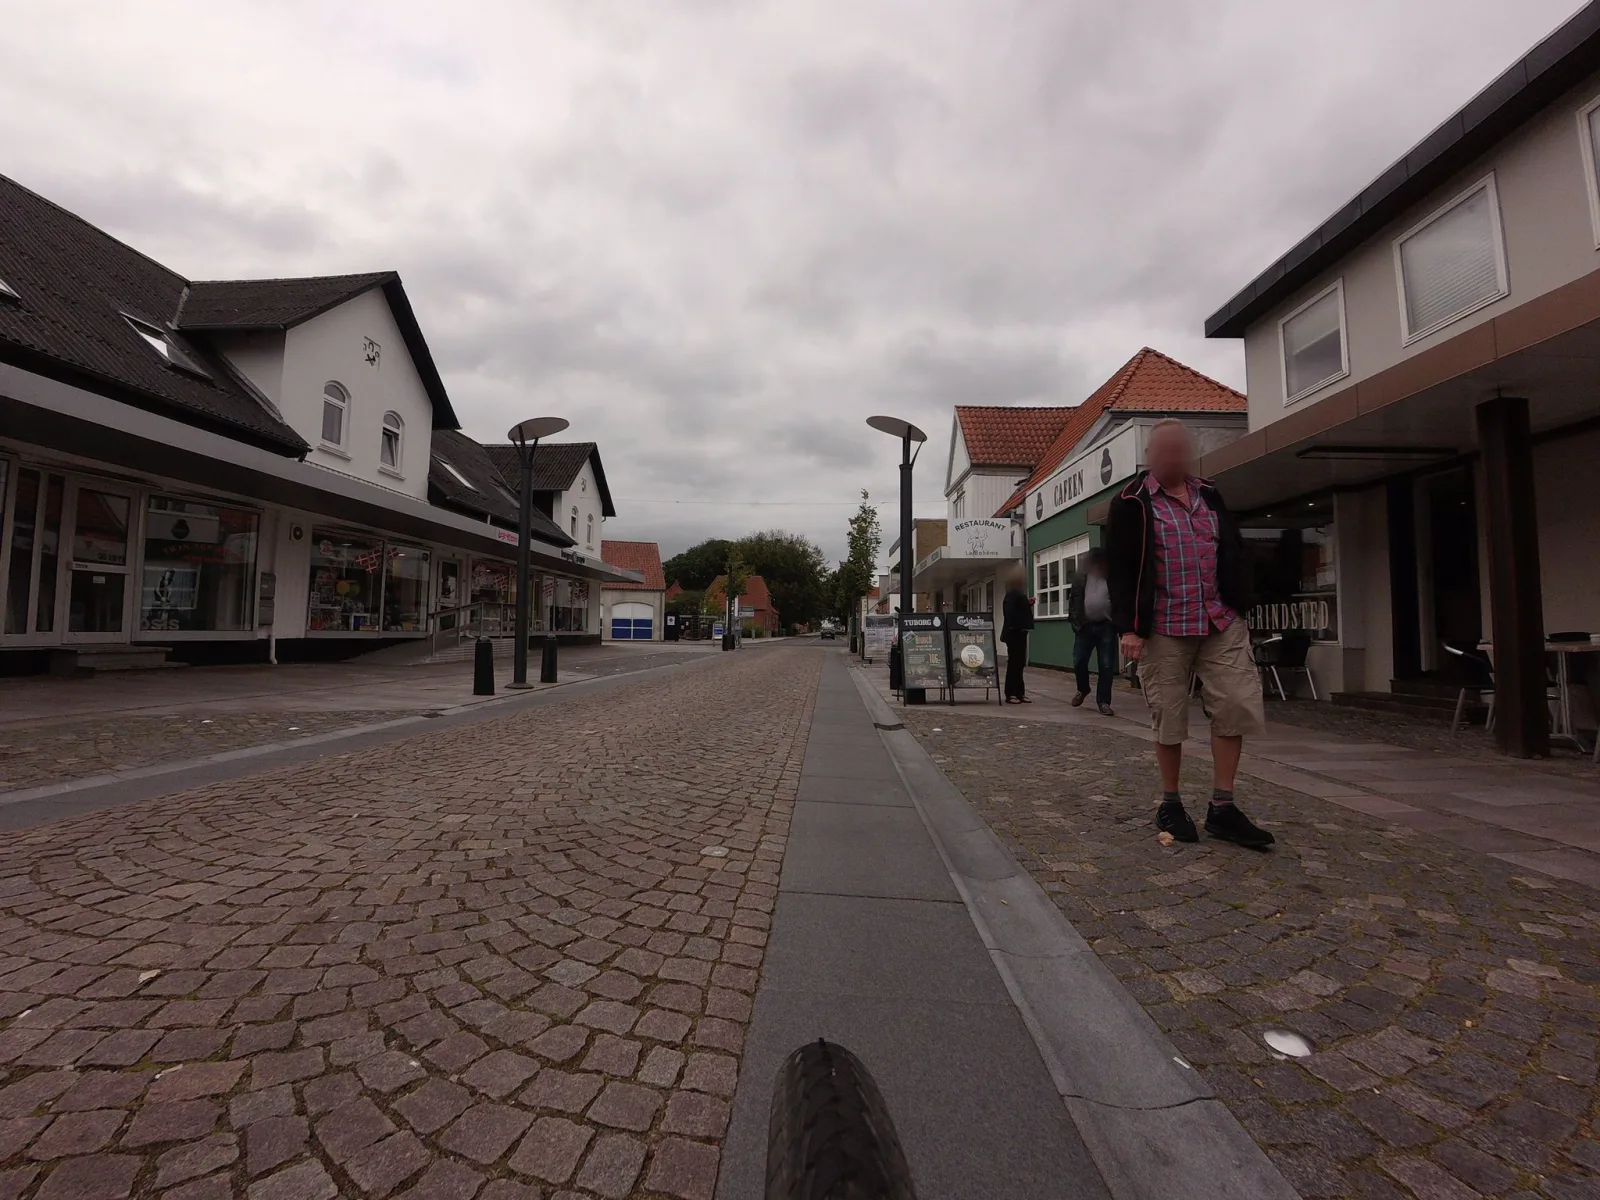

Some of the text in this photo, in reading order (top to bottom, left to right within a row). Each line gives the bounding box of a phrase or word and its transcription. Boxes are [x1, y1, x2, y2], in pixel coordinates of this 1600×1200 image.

[1054, 469, 1084, 507] CAFEEN
[954, 519, 1006, 532] RESTAURANT
[956, 615, 984, 626] Carlsberg
[1248, 601, 1328, 630] GRINDSTED
